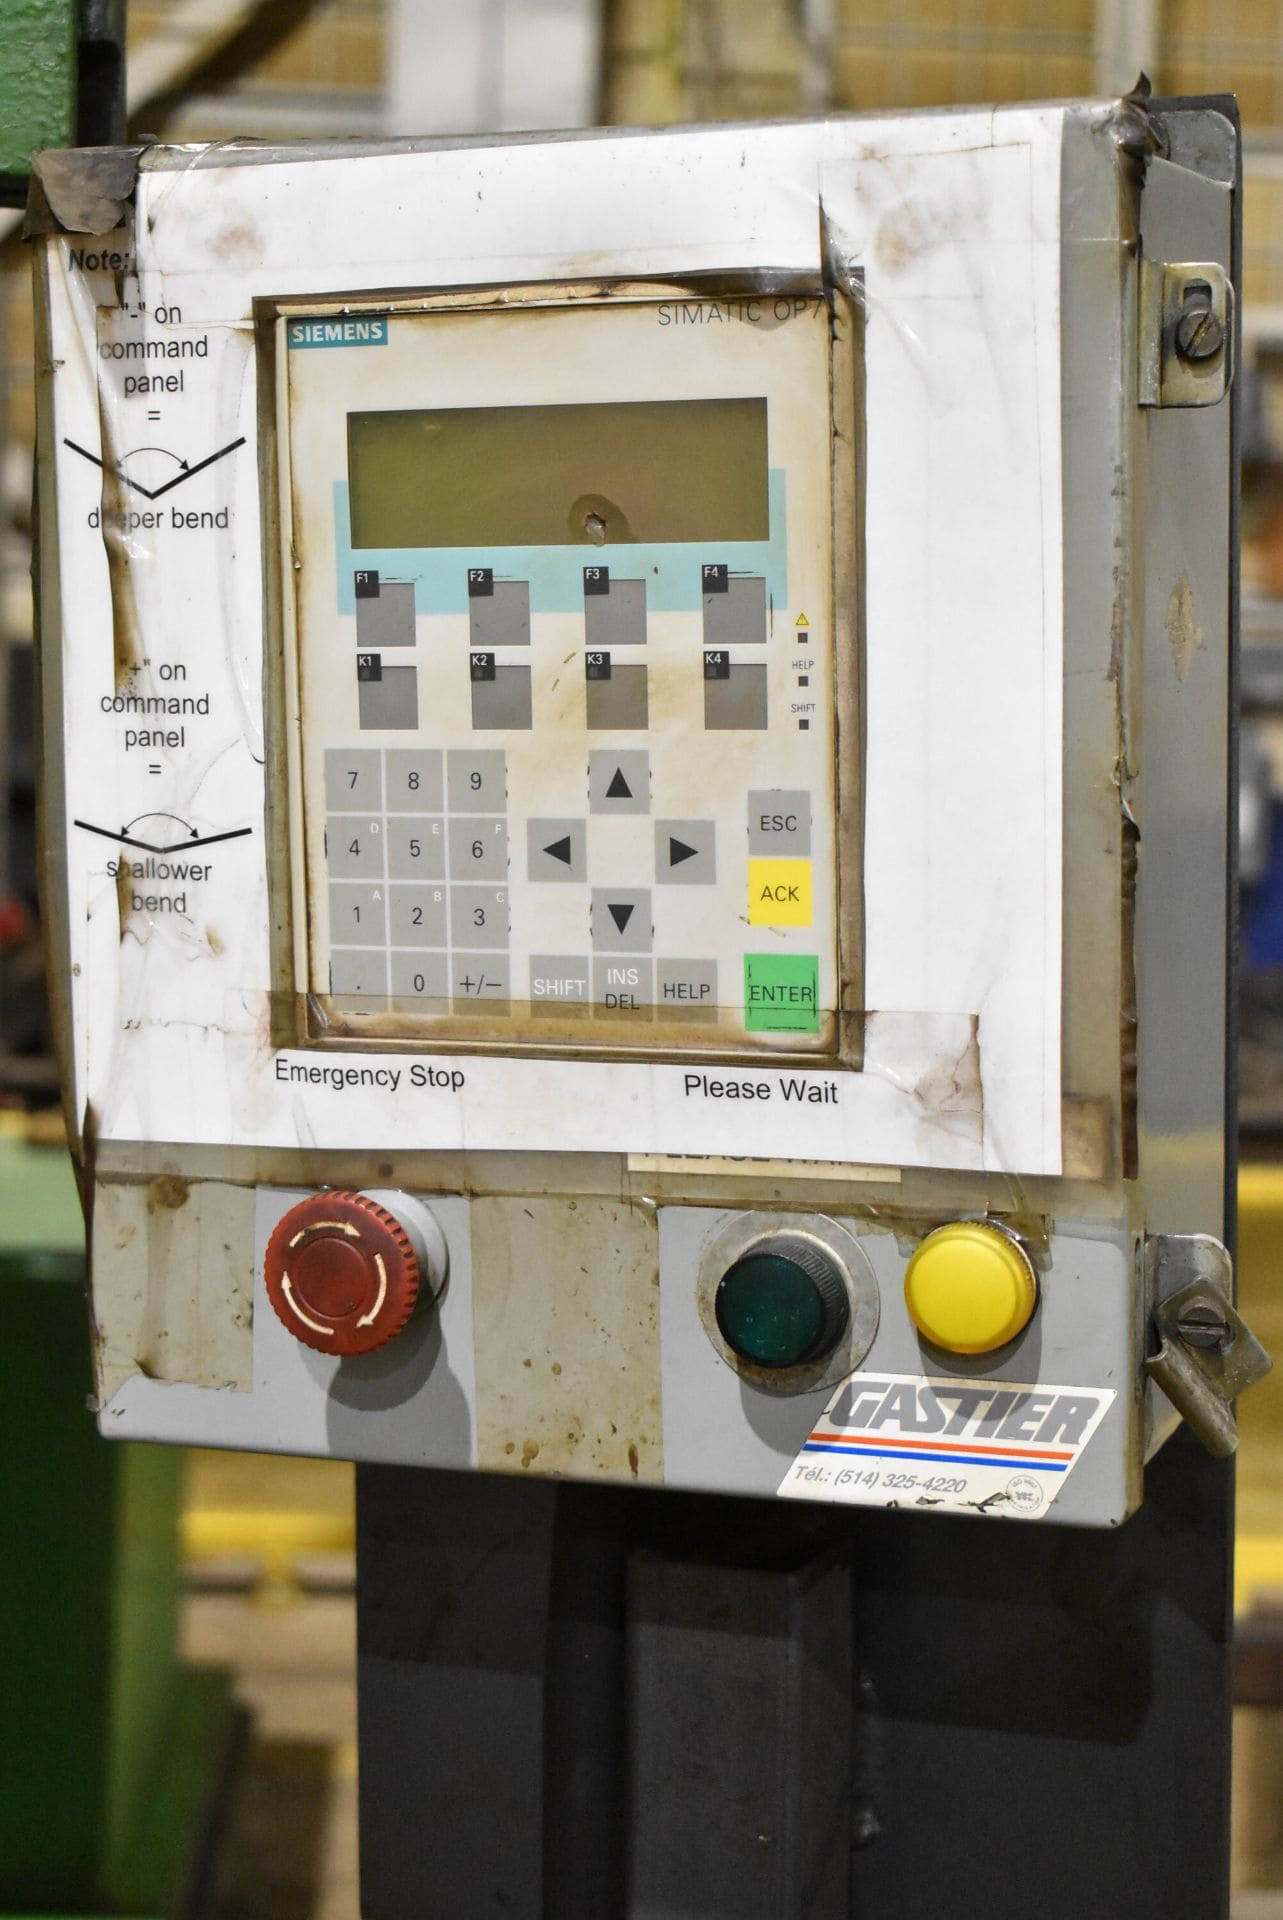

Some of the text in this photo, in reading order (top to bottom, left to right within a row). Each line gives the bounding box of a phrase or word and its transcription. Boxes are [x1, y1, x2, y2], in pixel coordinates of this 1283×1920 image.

[68, 248, 131, 272] Note:
[154, 306, 182, 324] on
[657, 300, 761, 326] SIMATIC
[292, 321, 383, 343] SIEMENS
[99, 335, 209, 360] command
[124, 370, 184, 396] panel
[87, 506, 229, 534] deper bend
[356, 573, 369, 583] F1
[470, 571, 484, 582] F2
[586, 569, 600, 580] F3
[704, 567, 719, 578] F4
[359, 656, 372, 667] K1
[472, 655, 488, 666] K2
[587, 654, 603, 665] K3
[705, 653, 722, 664] K4
[792, 660, 815, 670] HELP
[159, 664, 187, 681] on
[100, 693, 210, 715] command
[791, 703, 816, 713] SHIFT
[124, 726, 185, 751] panel
[347, 771, 358, 789] 7
[408, 772, 420, 790] 8
[470, 772, 482, 790] 9
[370, 823, 379, 833] D
[432, 824, 440, 834] E
[495, 824, 502, 834] F
[760, 815, 797, 832] ESC
[349, 839, 361, 856] 4
[410, 840, 421, 857] 5
[471, 840, 484, 858] 6
[131, 888, 187, 914] bend
[373, 890, 382, 900] A
[433, 891, 442, 902] B
[496, 892, 504, 902] C
[760, 885, 800, 902] ACK
[353, 906, 360, 923] 1
[412, 907, 423, 925] 2
[473, 908, 485, 926] 3
[413, 974, 425, 992] 0
[607, 968, 639, 985] INS
[533, 979, 586, 996] SHIFT
[663, 983, 711, 999] HELP
[750, 985, 812, 1002] ENTER
[605, 993, 640, 1010] DEL
[275, 1058, 465, 1092] Emergency Stop
[684, 1074, 838, 1103] Please Wait
[829, 1380, 1101, 1445] GASTIER
[834, 1469, 880, 1489] (514)
[882, 1474, 968, 1494] 325-4220
